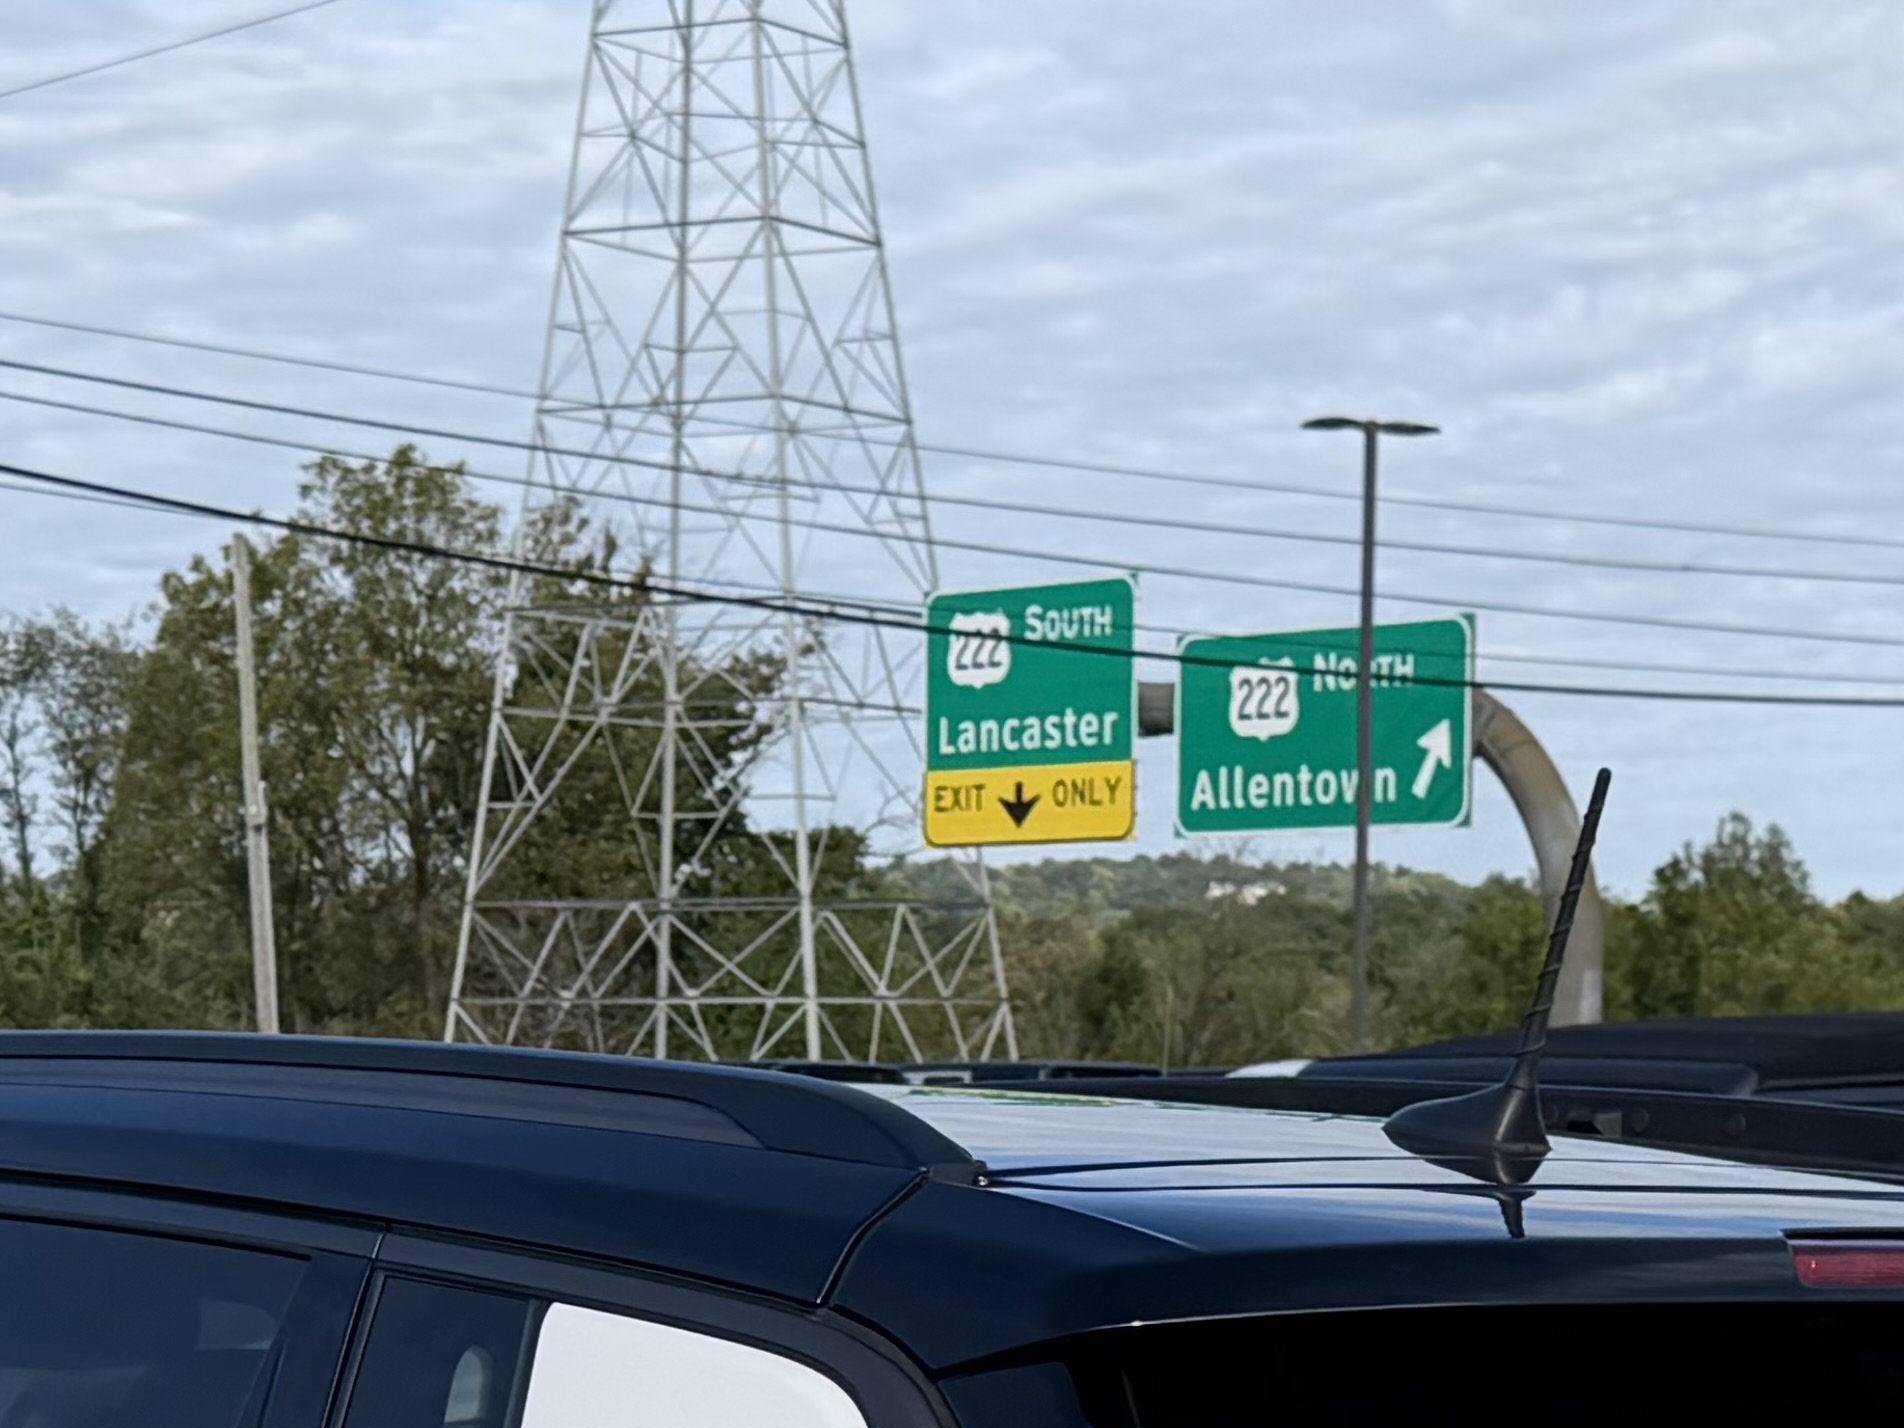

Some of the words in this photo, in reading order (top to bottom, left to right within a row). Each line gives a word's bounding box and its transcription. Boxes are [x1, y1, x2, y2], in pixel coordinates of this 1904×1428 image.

[1024, 604, 1112, 641] SOUTH
[1237, 676, 1290, 721] 222
[939, 707, 1119, 755] Lancaster
[934, 783, 986, 813] EXIT
[1052, 776, 1122, 807] ONLY
